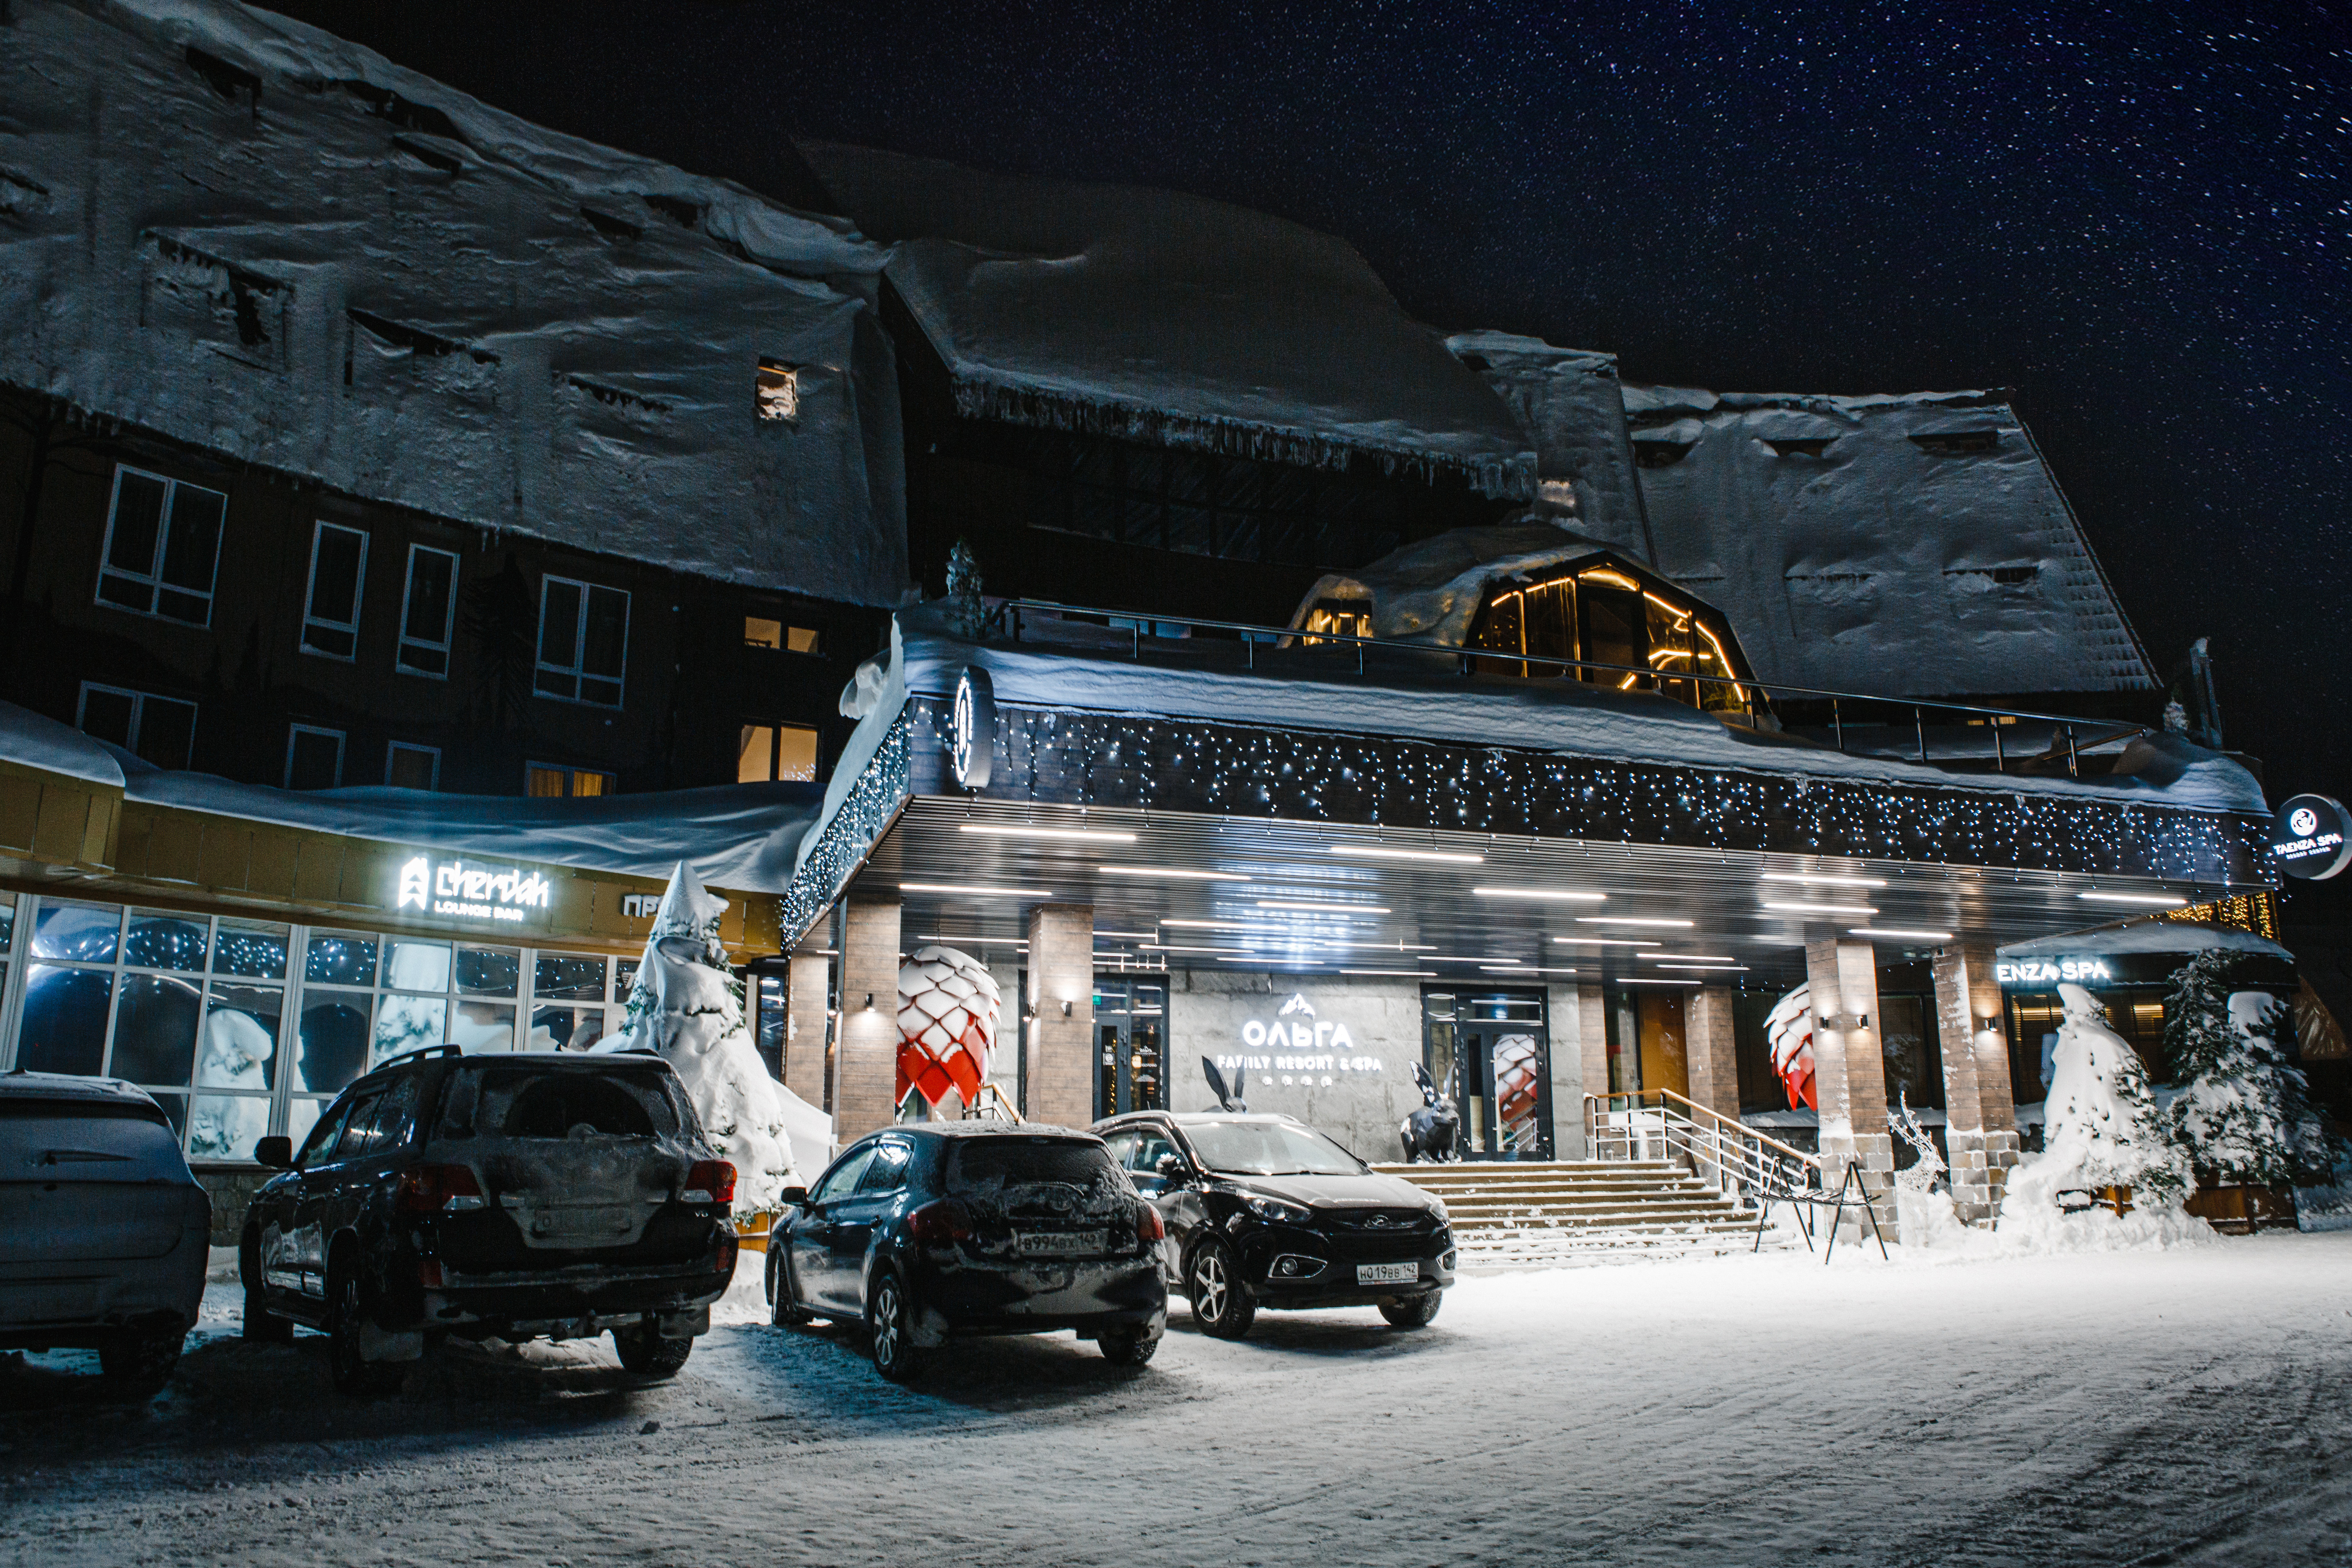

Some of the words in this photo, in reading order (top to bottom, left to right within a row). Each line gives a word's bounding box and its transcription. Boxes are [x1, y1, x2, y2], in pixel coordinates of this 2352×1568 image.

[2273, 839, 2317, 855] TAENZA
[2317, 833, 2342, 846] SPA
[435, 900, 492, 917] LOUNGE
[493, 907, 524, 921] BAR
[1997, 963, 2057, 981] ENZA
[2061, 962, 2109, 979] SPA
[1243, 1020, 1353, 1048] ОЛЬГА
[1276, 1056, 1333, 1070] RESORT
[1340, 1057, 1350, 1070] &
[1353, 1056, 1382, 1071] SPA
[1402, 1264, 1416, 1274] 142
